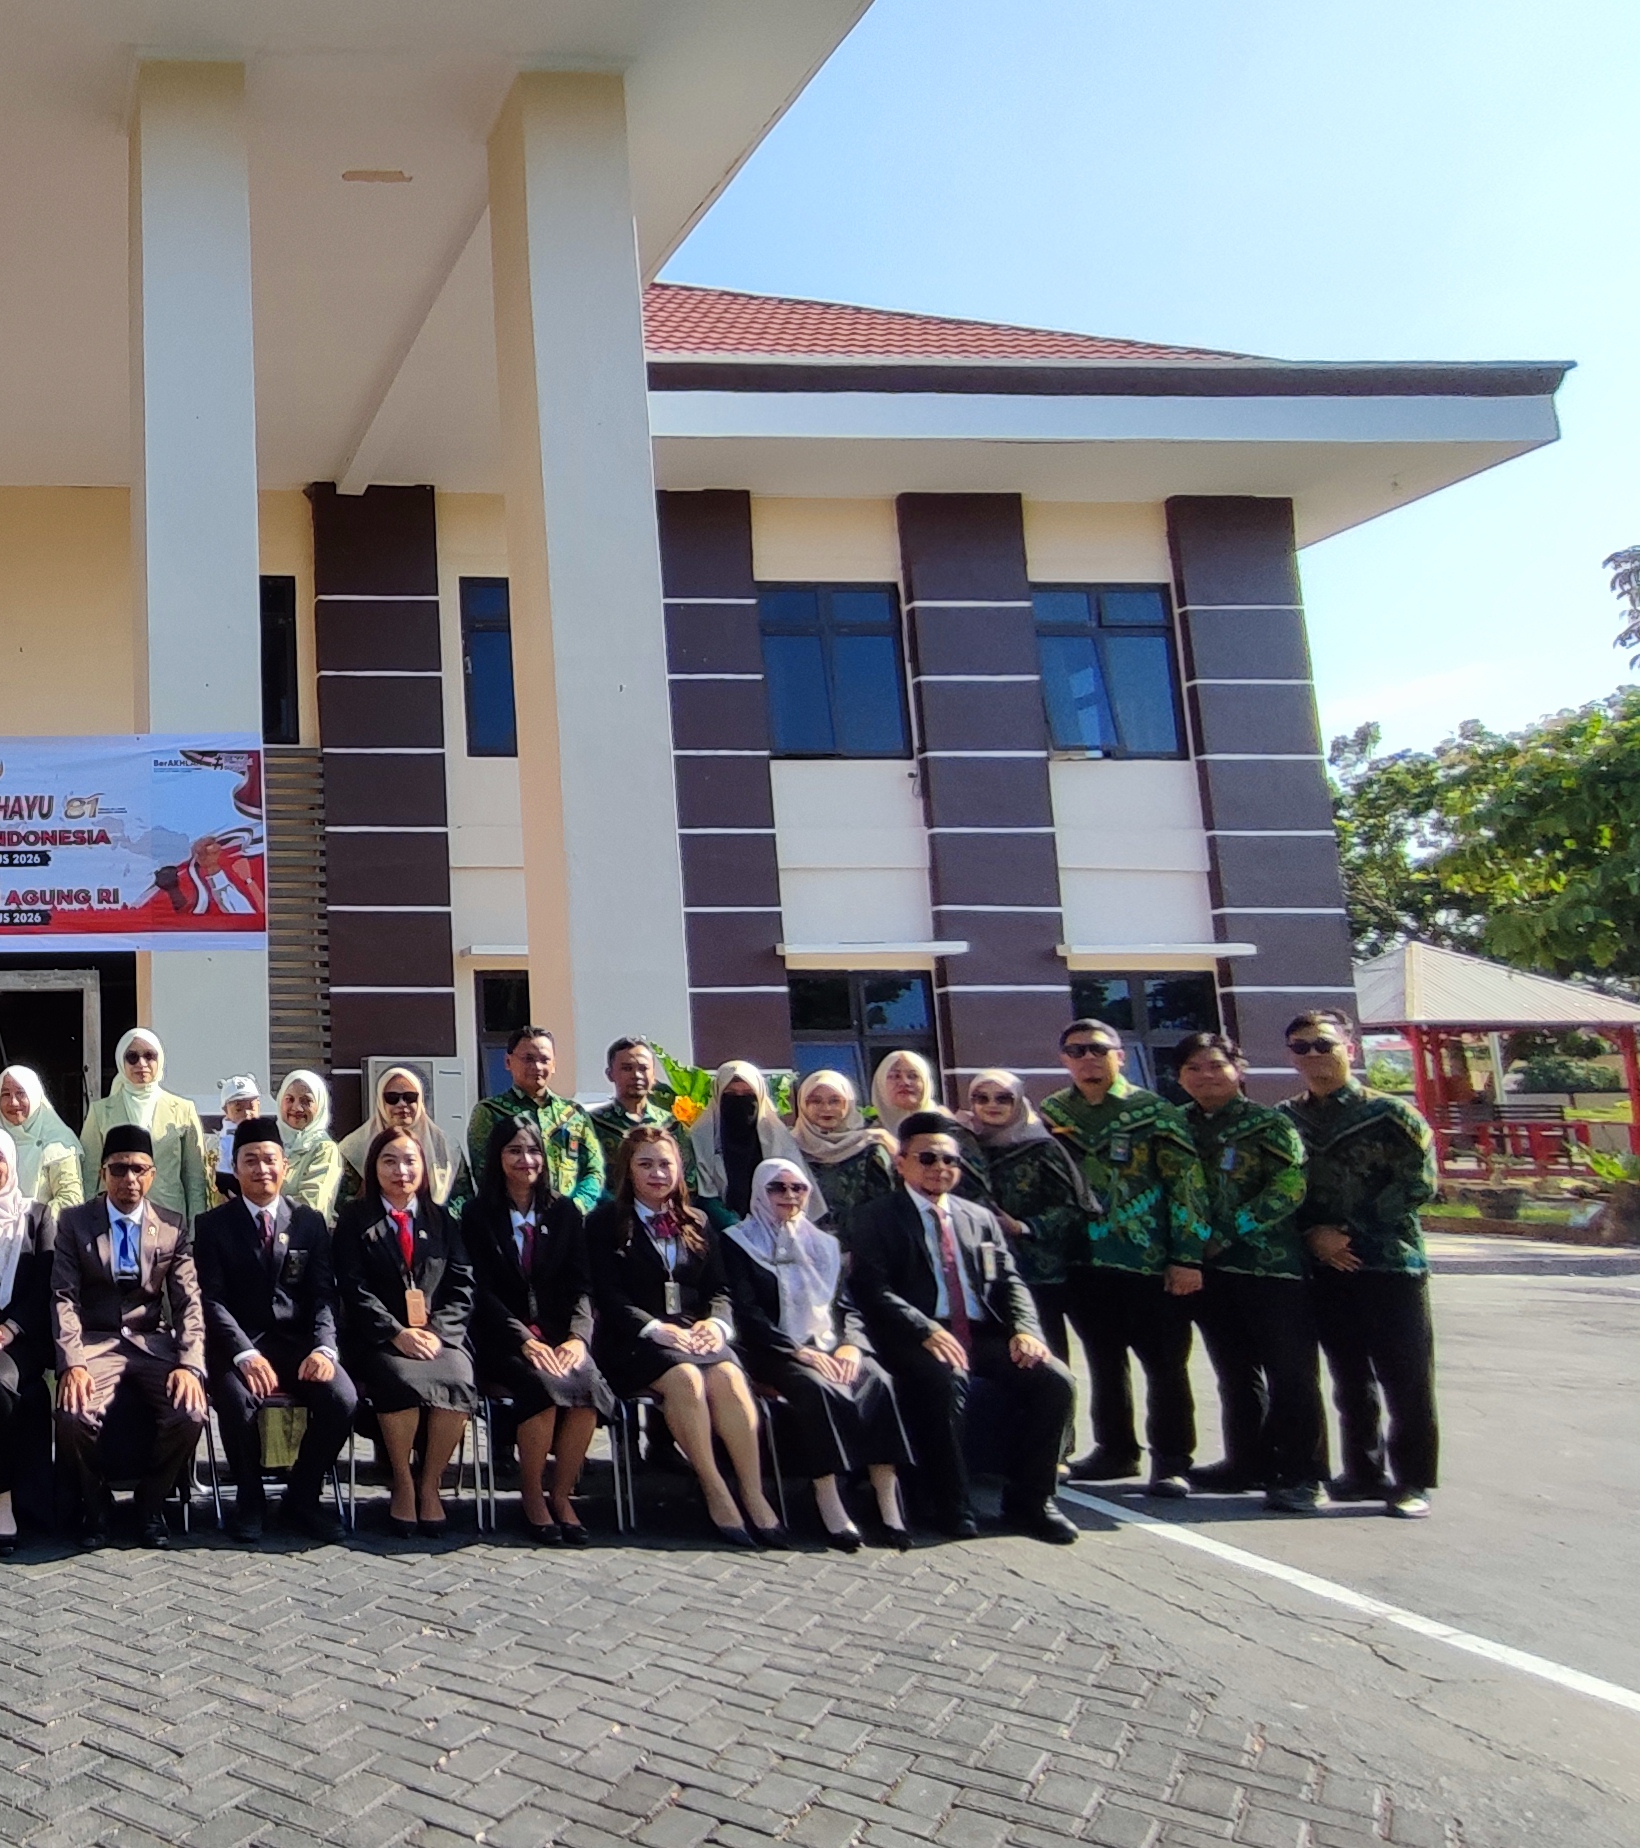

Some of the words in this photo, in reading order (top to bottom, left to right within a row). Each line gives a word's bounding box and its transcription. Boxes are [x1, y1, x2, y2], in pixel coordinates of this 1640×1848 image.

[12, 853, 41, 864] 2026
[5, 889, 91, 906] AGUNG
[97, 888, 118, 904] RI
[12, 912, 42, 924] 2026
